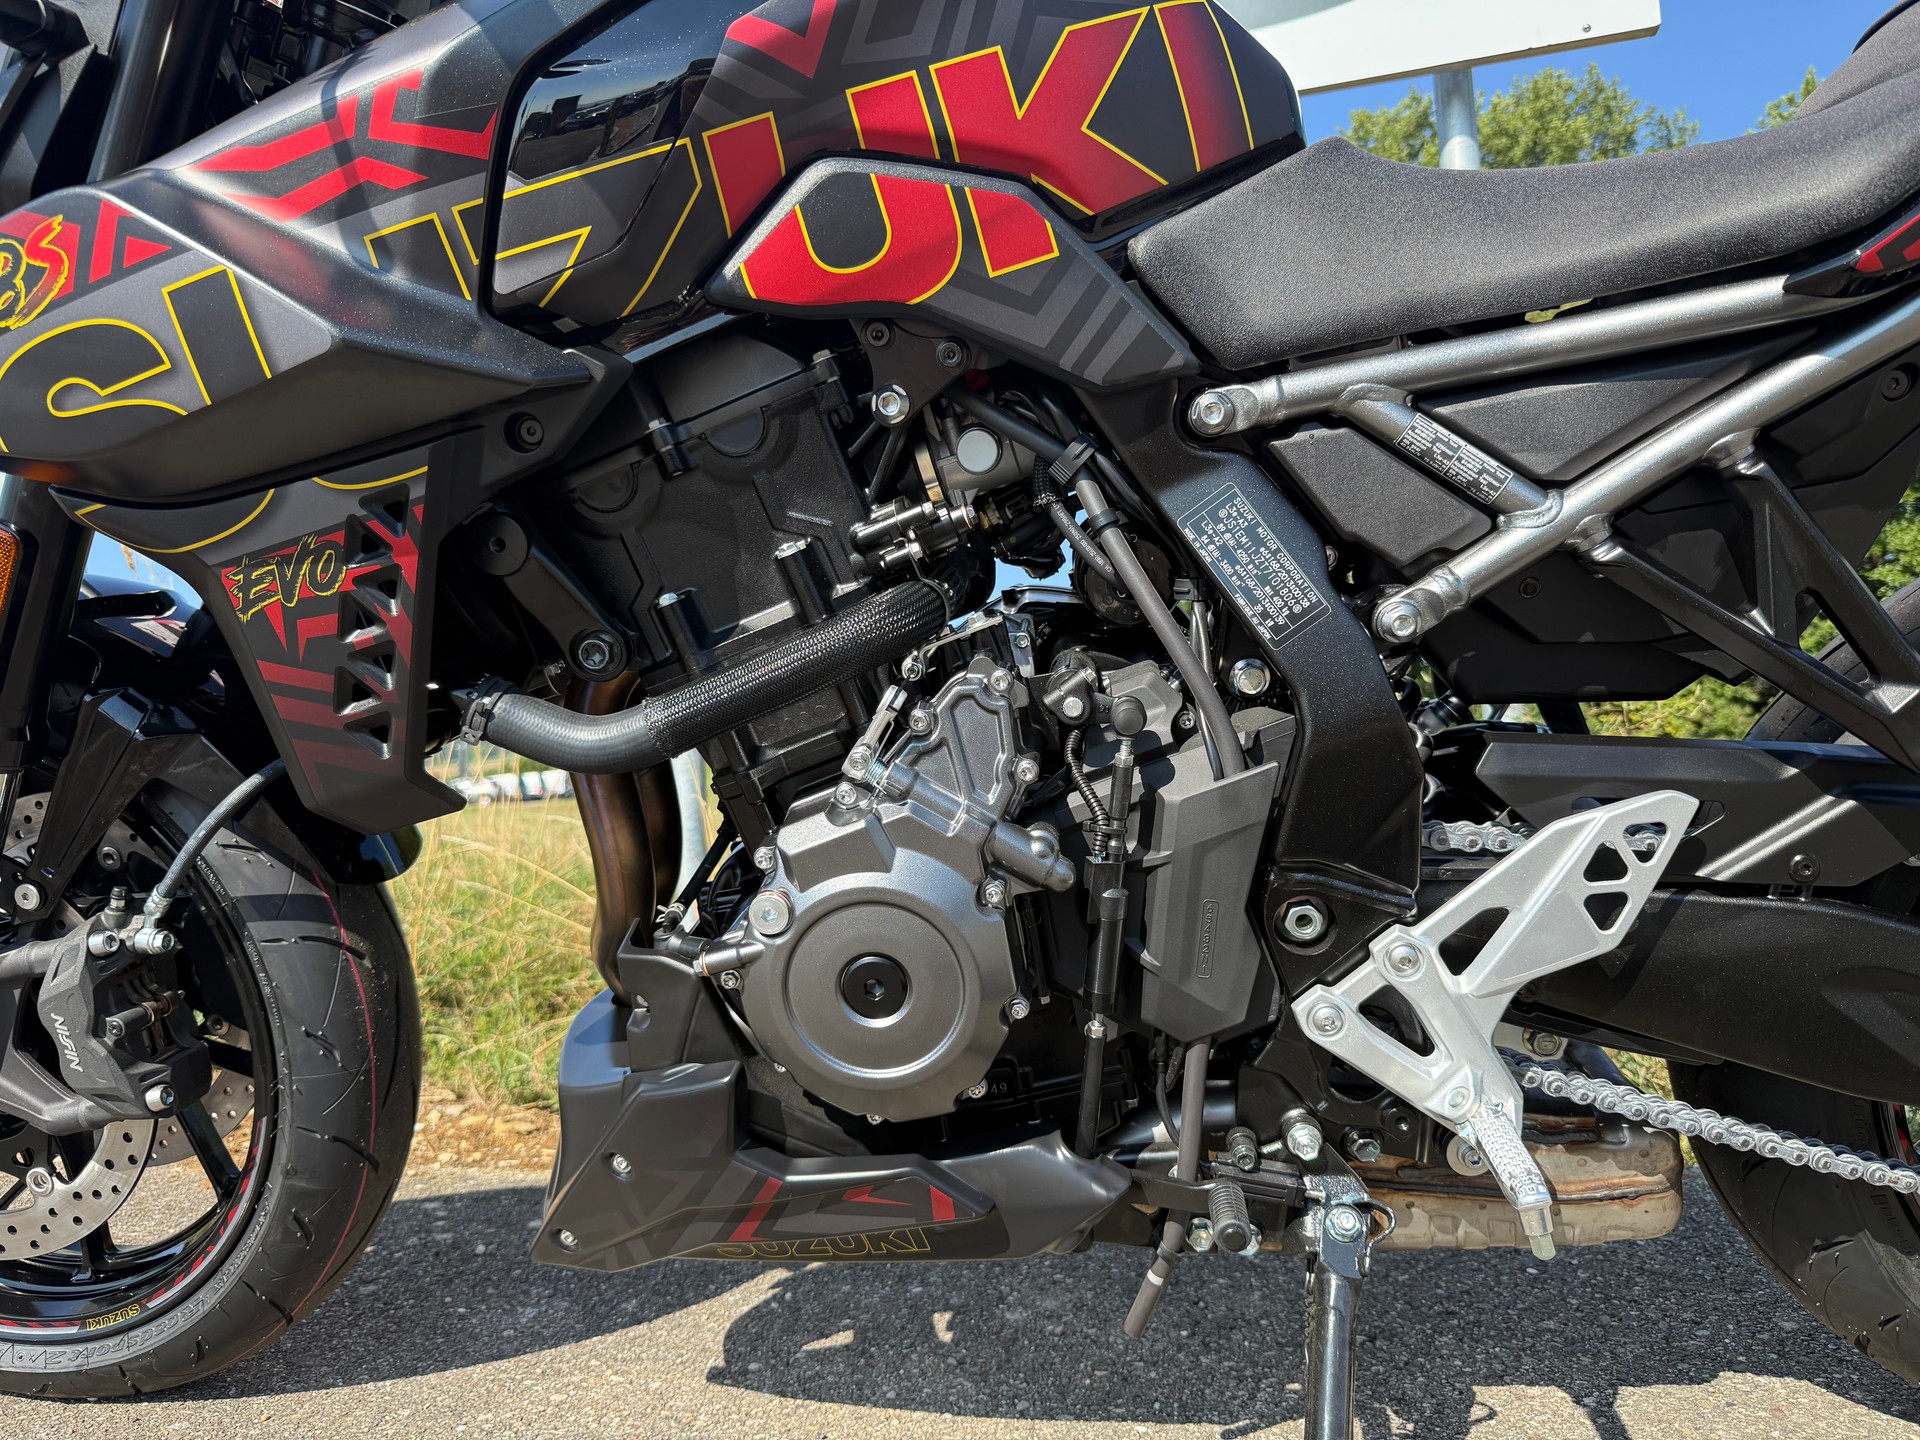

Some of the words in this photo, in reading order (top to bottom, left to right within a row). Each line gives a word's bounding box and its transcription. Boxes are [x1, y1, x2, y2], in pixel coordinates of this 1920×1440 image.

[1200, 519, 1224, 546] L3e-A2
[1224, 502, 1248, 528] L3e-A3
[1183, 527, 1195, 540] MADE
[1193, 540, 1201, 548] IN
[1198, 547, 1212, 563] JAPAN
[1232, 496, 1257, 524] SUZUKI
[1255, 526, 1278, 551] MOTOR
[1275, 551, 1318, 603] CORPORATION
[227, 532, 348, 623] EVO
[1200, 534, 1210, 544] 84
[1219, 559, 1234, 575] 3400
[1253, 602, 1264, 613] 35
[1264, 618, 1274, 627] kW
[1216, 522, 1226, 532] 89
[1235, 547, 1250, 564] 4250
[1263, 585, 1274, 596] max
[1272, 594, 1284, 608] 400
[1280, 606, 1291, 616] kg
[1233, 593, 1254, 617] FABRIQUE
[1251, 615, 1259, 624] AU
[1257, 623, 1272, 639] JAPON
[86, 1303, 141, 1332] SUZUKI
